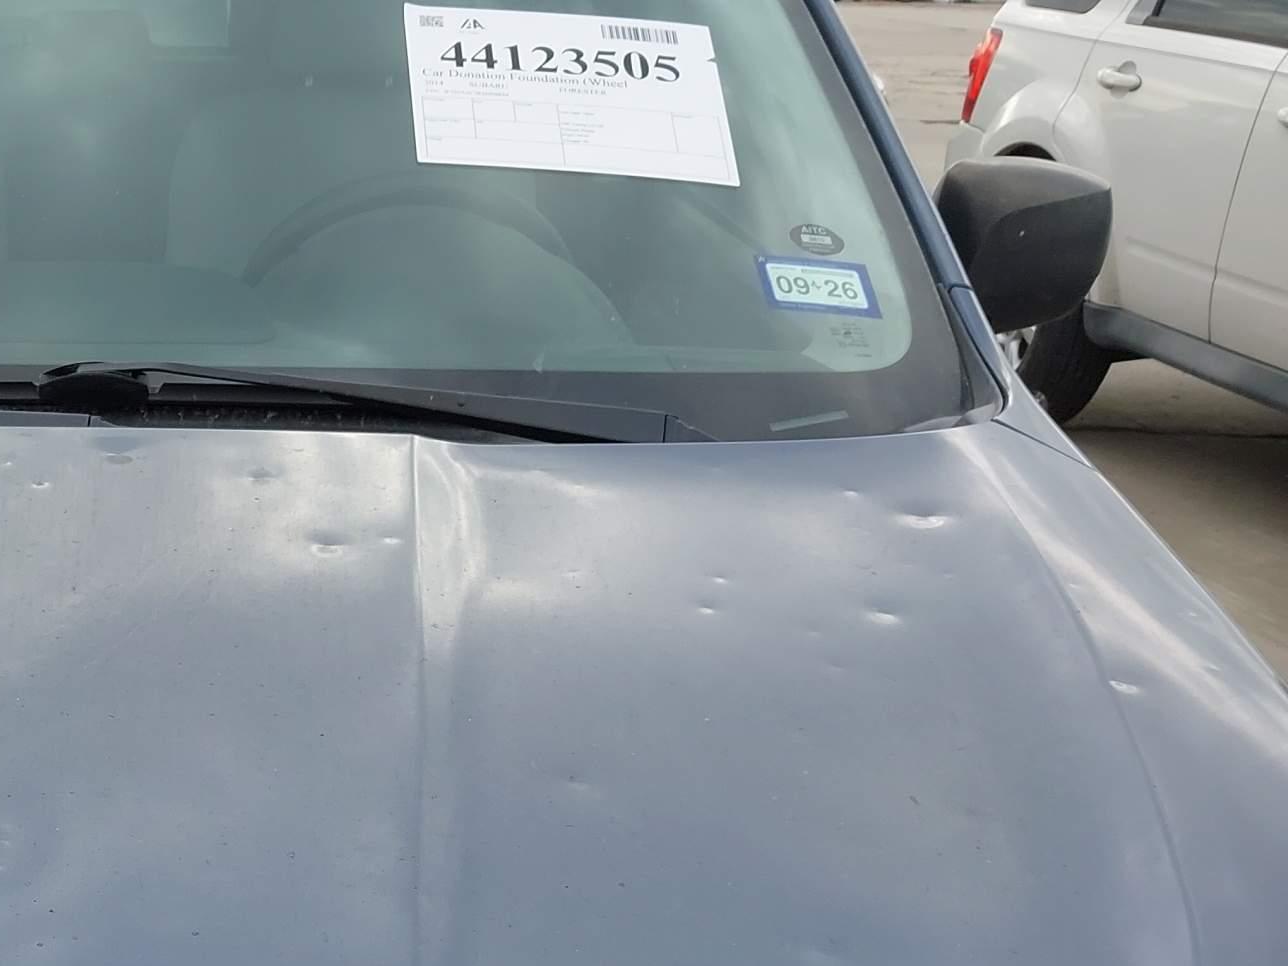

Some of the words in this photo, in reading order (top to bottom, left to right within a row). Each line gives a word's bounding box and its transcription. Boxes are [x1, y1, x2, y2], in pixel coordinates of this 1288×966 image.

[440, 41, 681, 83] 44123505
[422, 68, 444, 78] Car
[448, 69, 506, 81] Donation
[509, 73, 581, 85] Foundation
[582, 77, 628, 89] (Wheel
[775, 275, 811, 296] 09
[823, 279, 859, 300] 26
